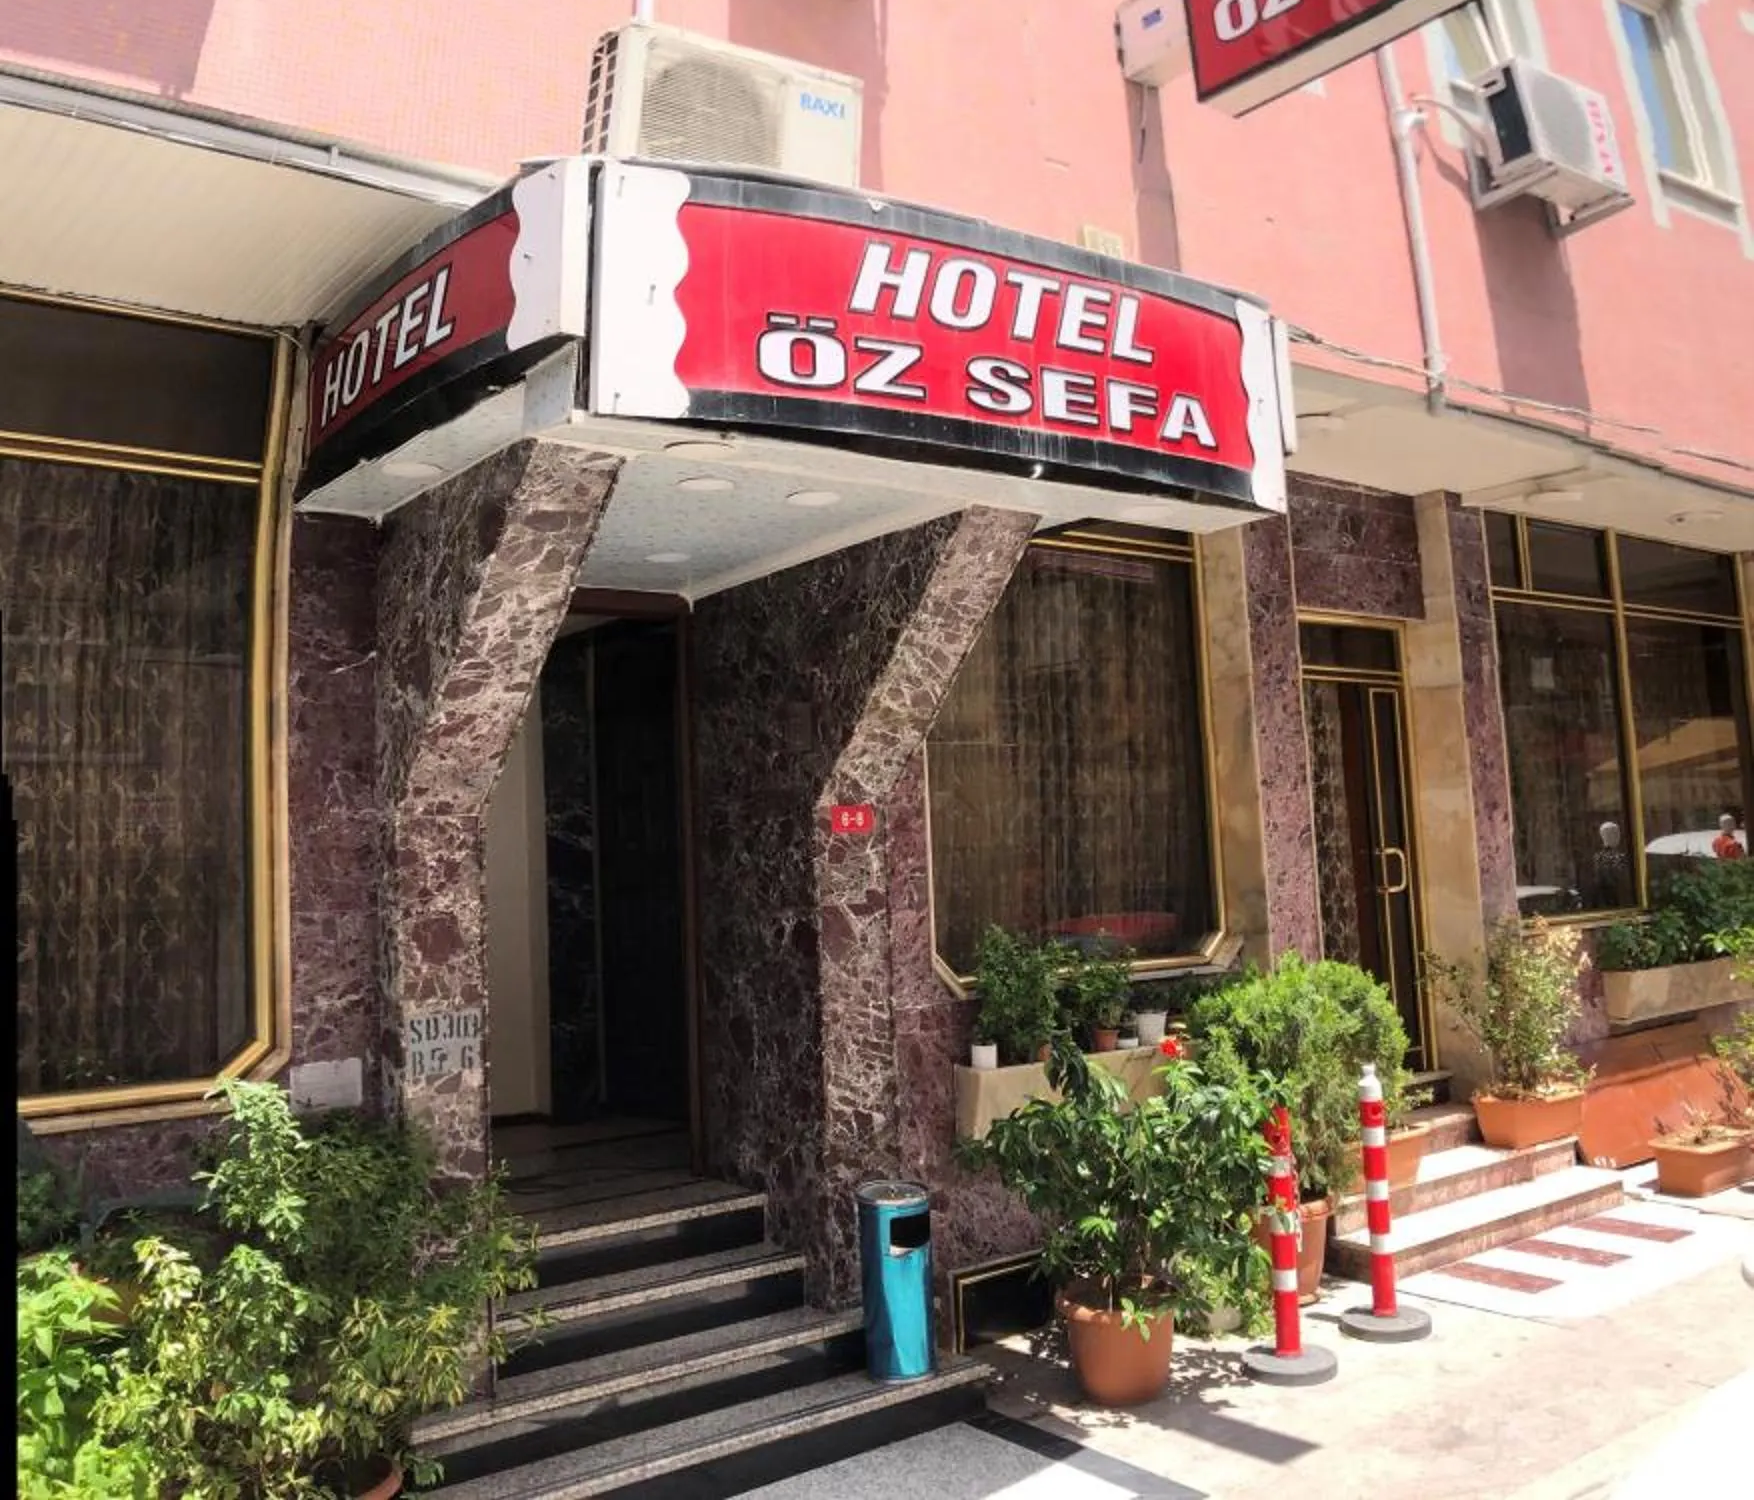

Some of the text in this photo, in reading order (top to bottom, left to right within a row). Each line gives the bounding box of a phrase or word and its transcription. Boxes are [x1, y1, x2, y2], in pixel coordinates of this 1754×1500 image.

[319, 262, 457, 430] HOTEL
[847, 238, 1155, 367] HOTEL
[755, 312, 1219, 450] ÖZ SEFA
